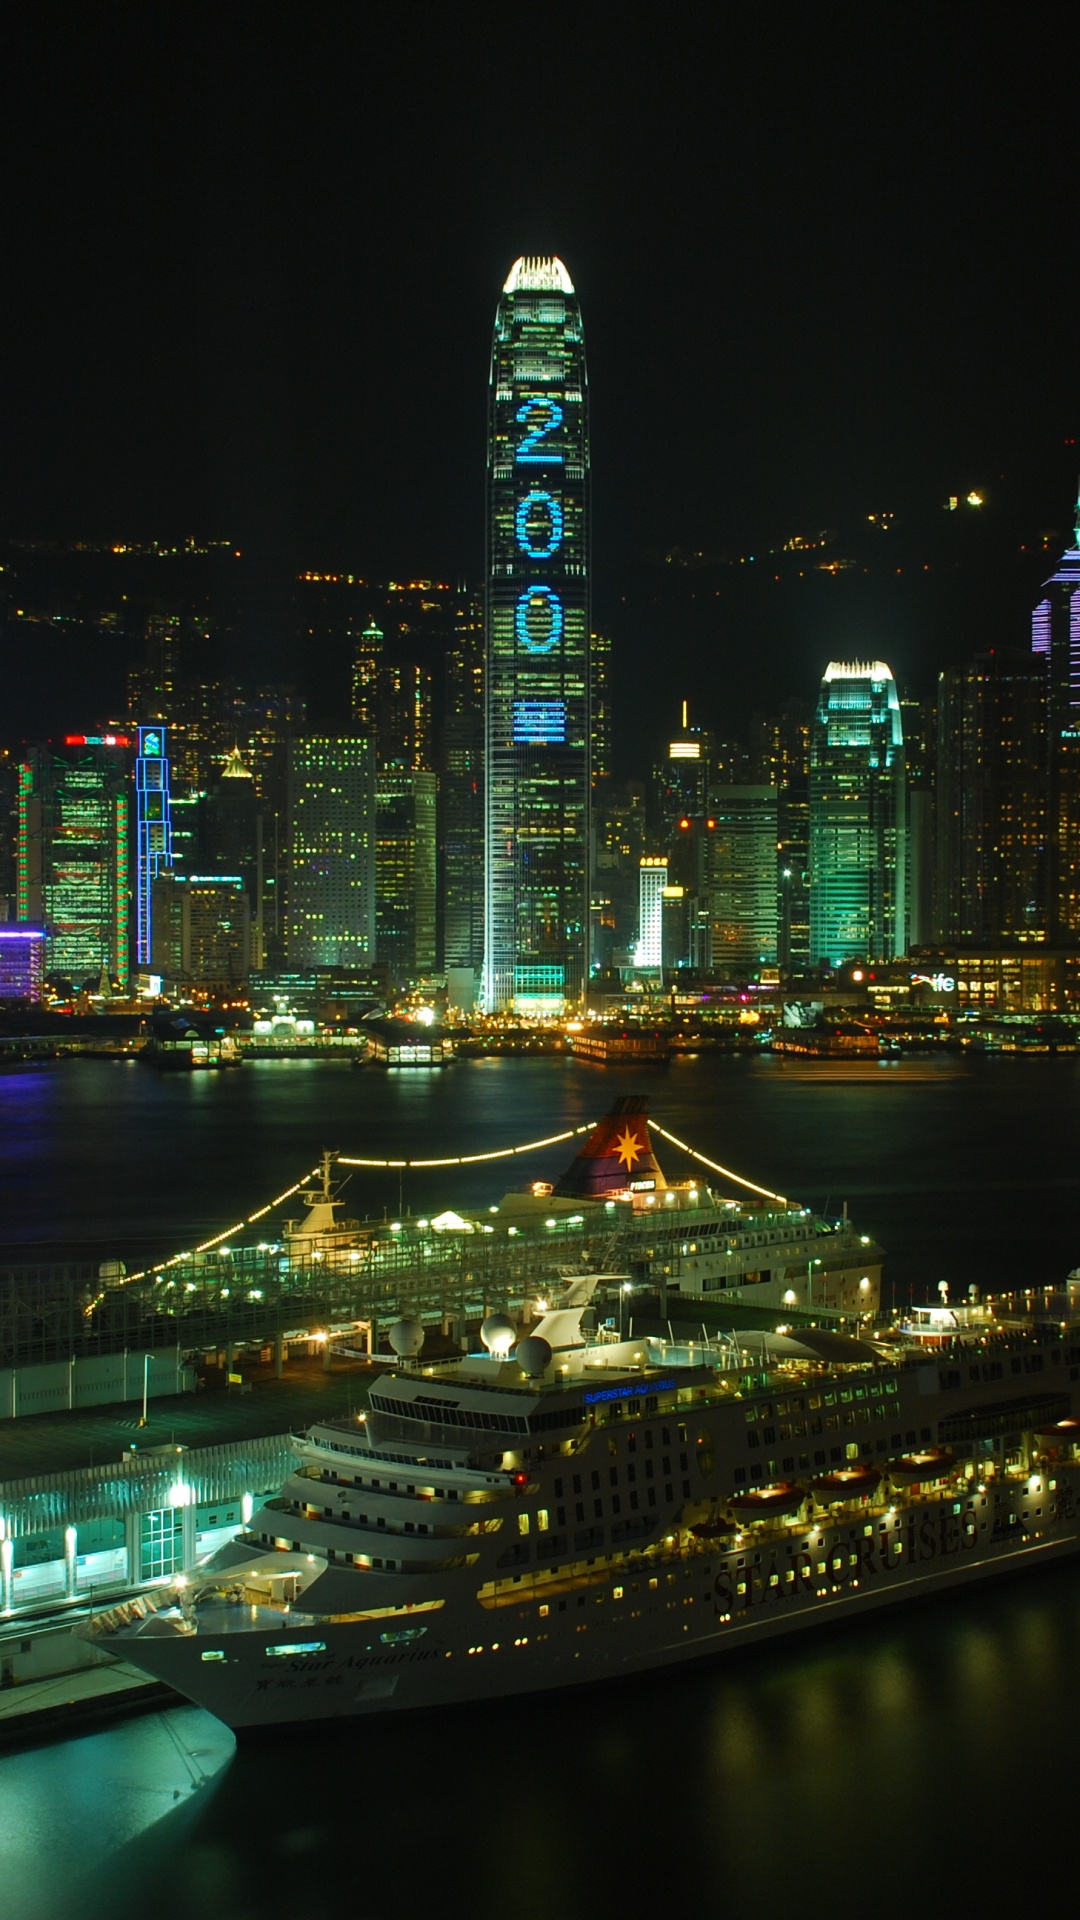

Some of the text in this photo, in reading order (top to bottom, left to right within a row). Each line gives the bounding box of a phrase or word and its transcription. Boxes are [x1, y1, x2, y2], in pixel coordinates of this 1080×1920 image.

[584, 1386, 633, 1404] SUPERSTAR
[714, 1510, 978, 1616] STAR CRUISES
[285, 1660, 335, 1673] Star
[338, 1647, 441, 1670] Aquarius
